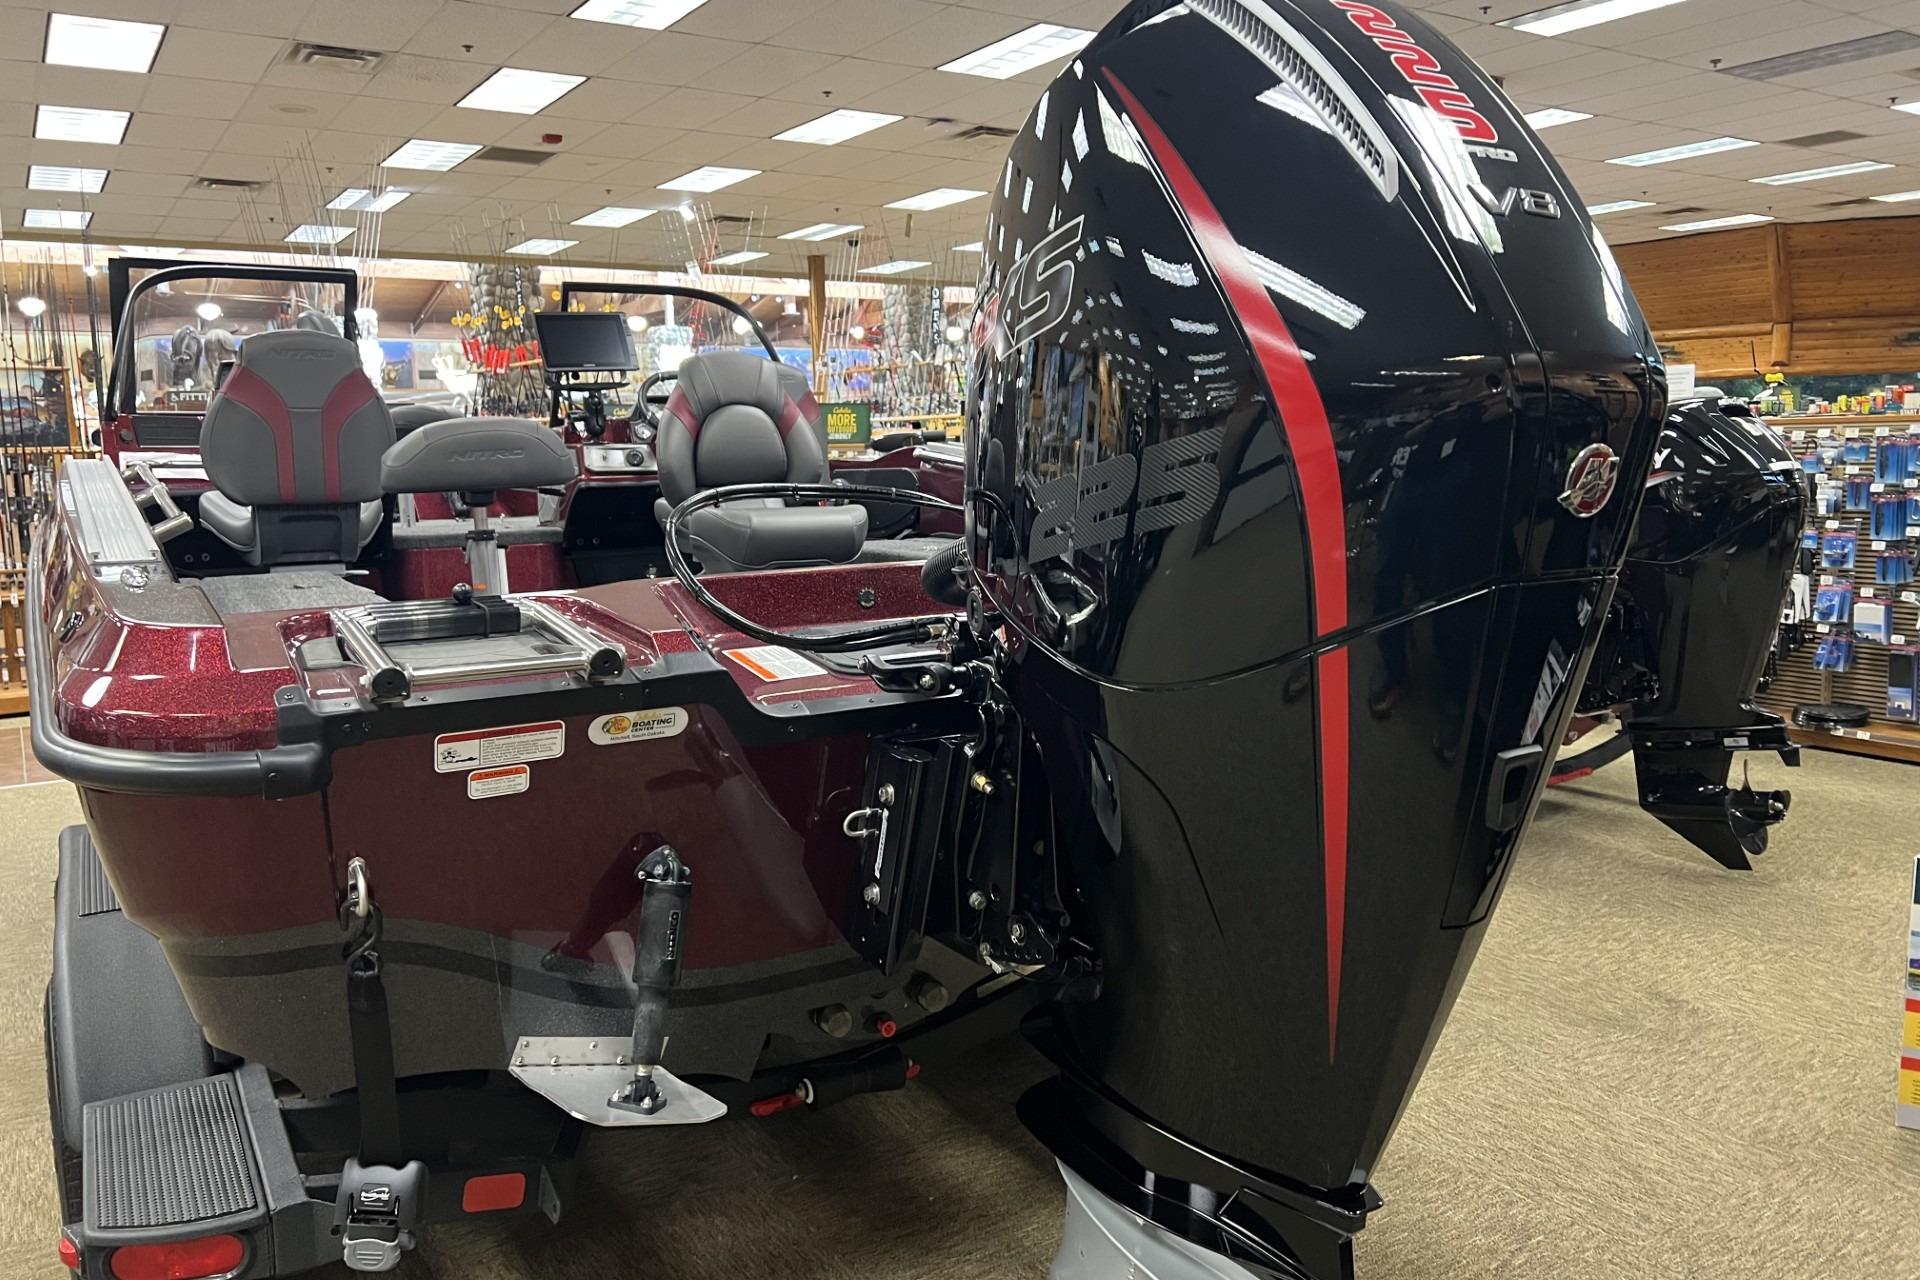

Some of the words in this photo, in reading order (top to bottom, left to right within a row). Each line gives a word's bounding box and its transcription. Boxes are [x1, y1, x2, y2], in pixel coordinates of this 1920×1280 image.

[1467, 186, 1561, 219] V8
[827, 413, 857, 426] MORE
[448, 447, 525, 462] NITRO
[632, 717, 673, 728] BOATING
